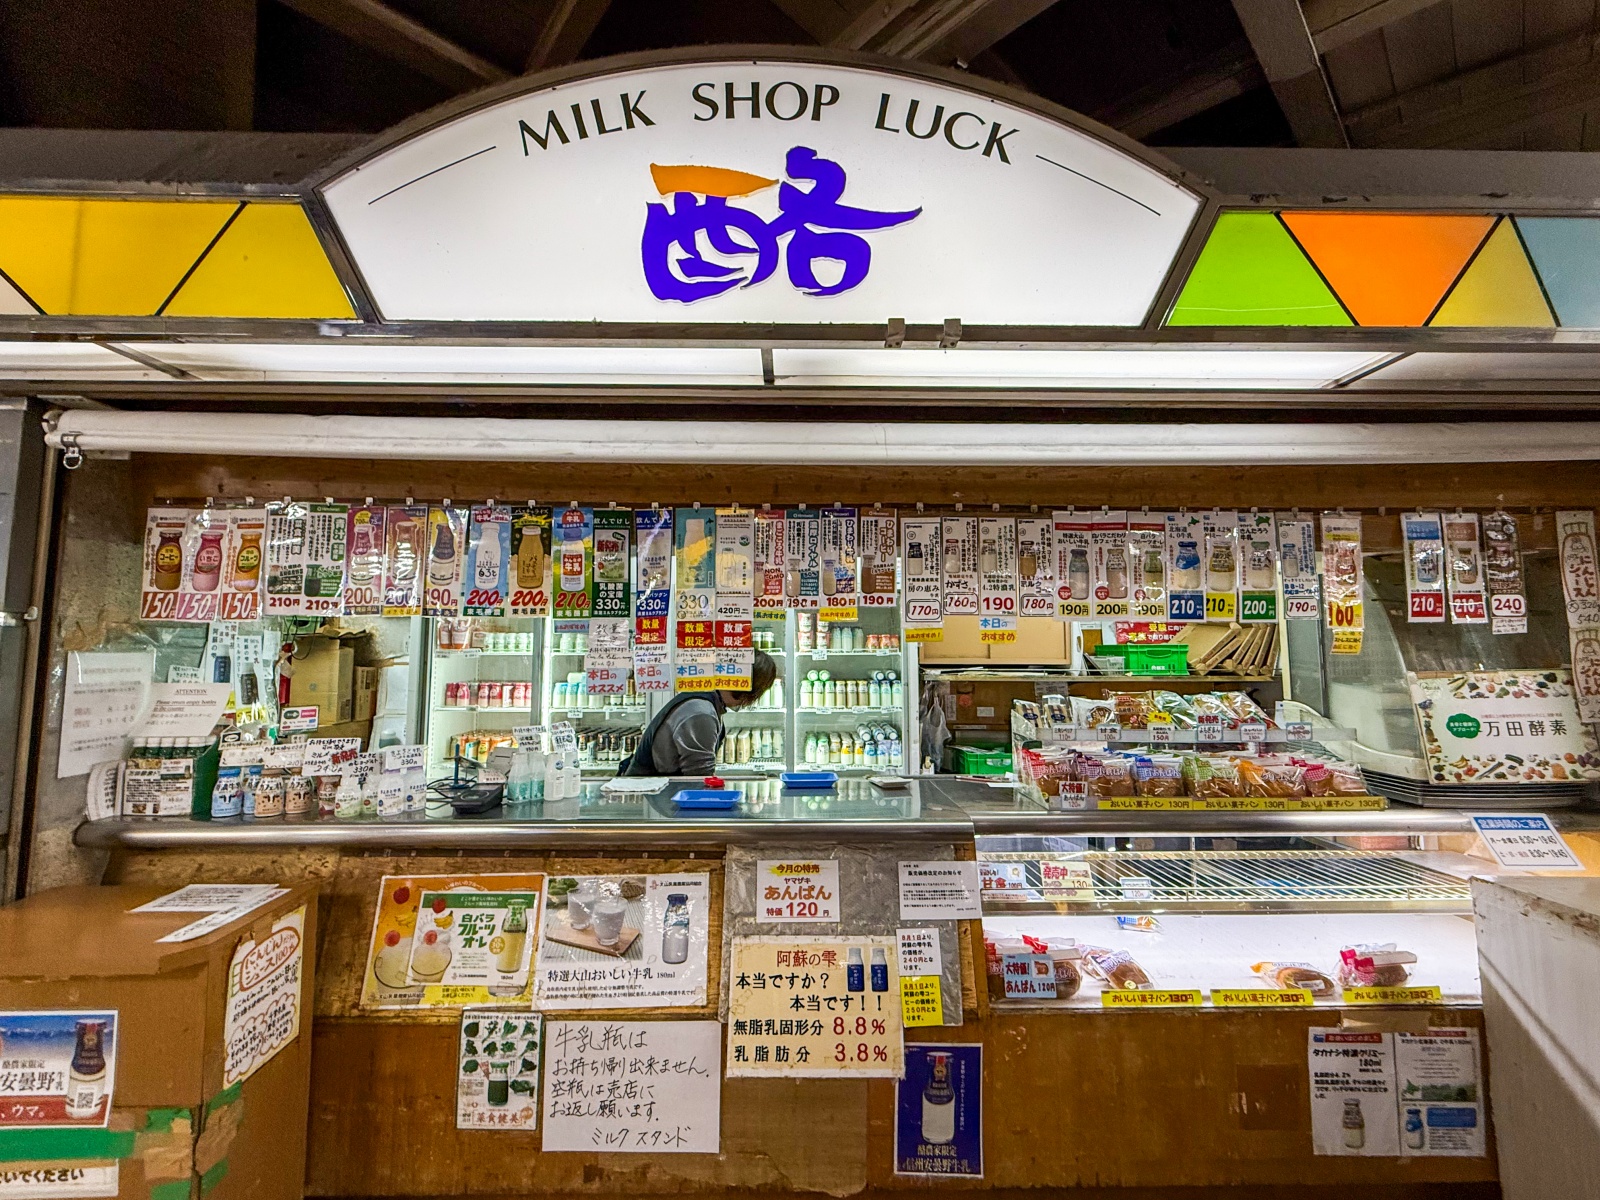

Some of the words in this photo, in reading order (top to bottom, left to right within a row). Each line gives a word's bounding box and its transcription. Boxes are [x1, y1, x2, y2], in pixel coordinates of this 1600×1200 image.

[519, 88, 654, 157] MILK
[690, 81, 841, 122] SHOP
[874, 91, 1023, 167] LUCK
[594, 517, 630, 525] 飲んでけし
[885, 520, 895, 556] ひまわり
[564, 562, 581, 572] 牛乳
[599, 582, 624, 591] 乳酸菌
[907, 585, 940, 593] 房の恵み
[945, 580, 969, 590] かずさ
[345, 588, 380, 604] 200円
[466, 590, 504, 607] 200円
[511, 590, 549, 607] 200円
[599, 590, 624, 599] の宝庫
[178, 593, 214, 619] 150円
[223, 593, 258, 619] 150円
[269, 597, 300, 607] 210円
[555, 592, 591, 609] 210円
[595, 599, 625, 610] 330円
[639, 600, 666, 610] 330円
[753, 597, 784, 608] 200円
[826, 597, 856, 607] 180円
[863, 596, 894, 605] 190円
[947, 597, 977, 608] 160円
[982, 597, 1015, 611] 190
[1024, 599, 1054, 610] 180円
[1493, 598, 1522, 611] 240
[717, 606, 741, 615] 420円
[911, 605, 939, 616] 170円
[1060, 604, 1089, 616] 190円
[1096, 604, 1128, 616] 200円
[1171, 600, 1203, 616] 210円
[1243, 600, 1275, 616] 200円
[1288, 601, 1317, 613] 190円
[1412, 598, 1442, 615] 210円
[641, 619, 660, 629] 数量
[684, 623, 705, 633] 数量
[723, 623, 744, 633] 数量
[980, 617, 1008, 629] 本日の
[641, 631, 660, 642] 限定
[684, 636, 705, 646] 限定
[723, 636, 742, 647] 限定
[981, 632, 1016, 642] おすすめ
[587, 669, 617, 681] 本日の
[637, 665, 662, 677] 本日の
[676, 665, 705, 676] 本日の
[715, 664, 743, 675] 本日の
[588, 683, 624, 694] オススメ
[638, 680, 670, 690] オススメ
[678, 679, 713, 689] おすすめ
[715, 679, 749, 688] おすすめ
[1197, 715, 1219, 724] 新発売
[1483, 719, 1568, 737] 万田酵素
[331, 749, 358, 765] 新発売
[1110, 800, 1164, 809] おいしい菓子パン
[1168, 800, 1190, 809] 130円
[1205, 800, 1259, 809] おいしい菓子パン
[1263, 800, 1286, 809] 130円
[1300, 800, 1354, 809] おいしい菓子パン
[1358, 800, 1381, 809] 130円
[776, 863, 820, 874] 今月の特売
[1043, 866, 1069, 880] 発売中
[784, 877, 812, 885] ヤマザキ
[982, 877, 1007, 888] 甘食
[764, 885, 832, 901] あんぱん
[766, 907, 783, 917] 特価
[786, 902, 819, 917] 120
[822, 909, 830, 917] 円
[461, 913, 496, 923] 白バラ
[458, 924, 496, 936] フルーツ
[462, 936, 488, 949] オ・レ
[776, 950, 837, 968] 阿蘇の雫
[547, 967, 654, 983] 特選大山おいしい牛乳
[735, 972, 830, 990] 本当ですか？
[1005, 981, 1037, 994] あんぱん
[789, 994, 884, 1012] 本当です！！
[733, 1019, 824, 1036] 無脂乳固形分
[832, 1016, 887, 1035] 8.8%
[554, 1024, 649, 1057] 牛乳瓶は
[734, 1045, 811, 1062] 乳脂肪分
[834, 1043, 888, 1062] 3.8%
[2, 1060, 45, 1069] 酪農家限定
[1, 1072, 54, 1092] 安曇野
[551, 1080, 655, 1100] 空瓶は売店に
[591, 1127, 630, 1147] ミルク
[636, 1126, 693, 1148] スタンド
[917, 1145, 958, 1158] 酪農家限定
